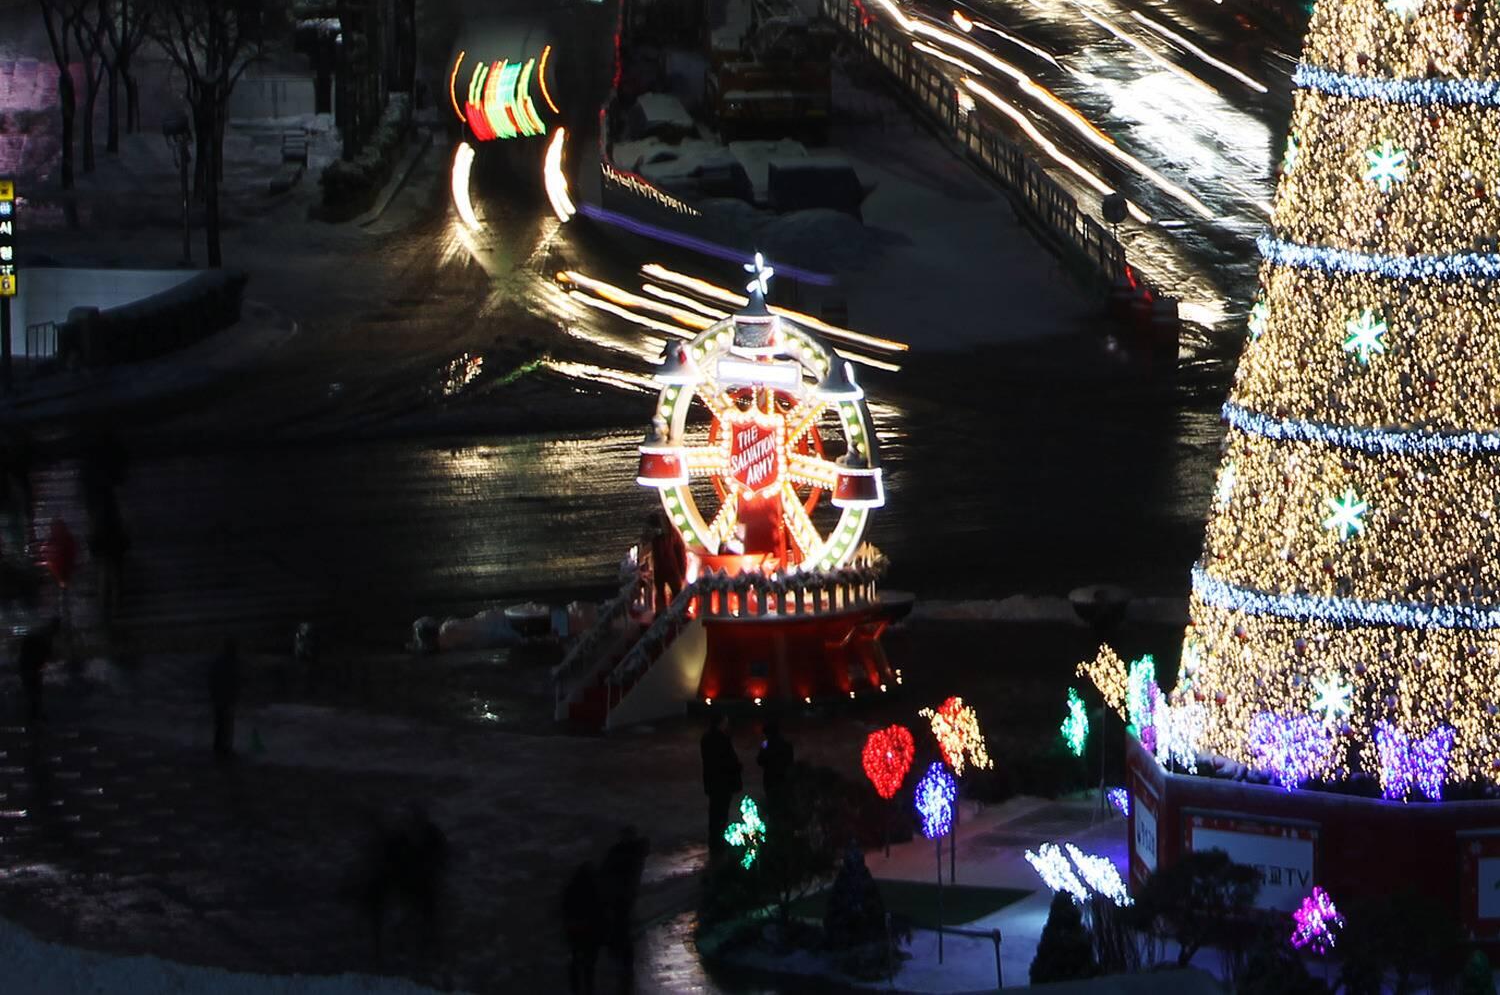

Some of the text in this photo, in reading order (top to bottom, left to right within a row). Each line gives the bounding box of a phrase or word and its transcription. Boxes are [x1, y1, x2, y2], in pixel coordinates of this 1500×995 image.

[731, 431, 776, 472] SALVATION
[737, 425, 759, 451] THE
[746, 453, 775, 486] ARMY
